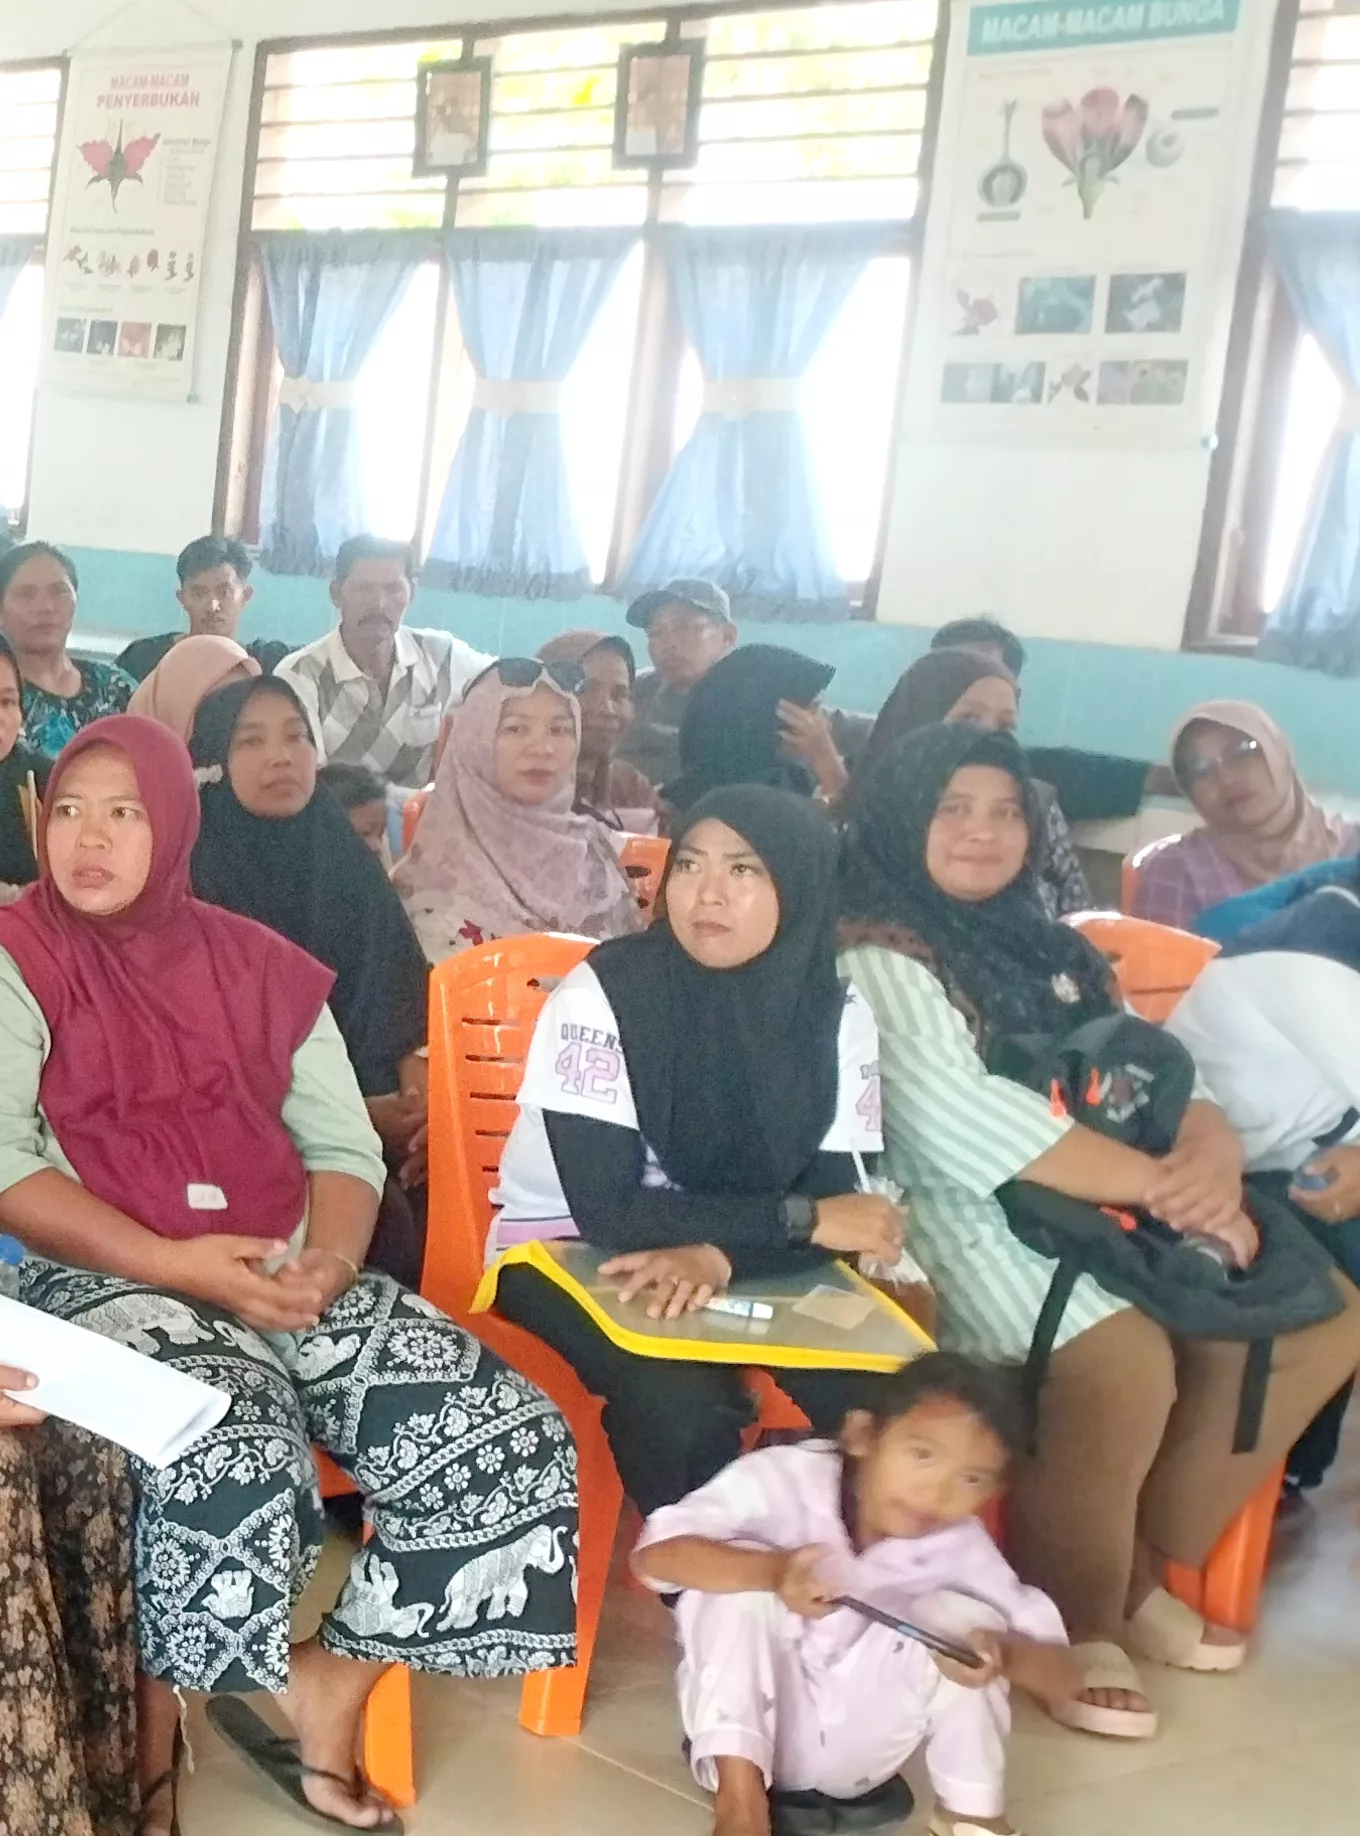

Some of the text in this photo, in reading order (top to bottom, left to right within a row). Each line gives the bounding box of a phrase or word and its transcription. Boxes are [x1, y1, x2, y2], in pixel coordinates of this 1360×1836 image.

[96, 91, 201, 109] PENYERBUKAN
[561, 1023, 623, 1054] QUEEN
[554, 1041, 621, 1105] 42
